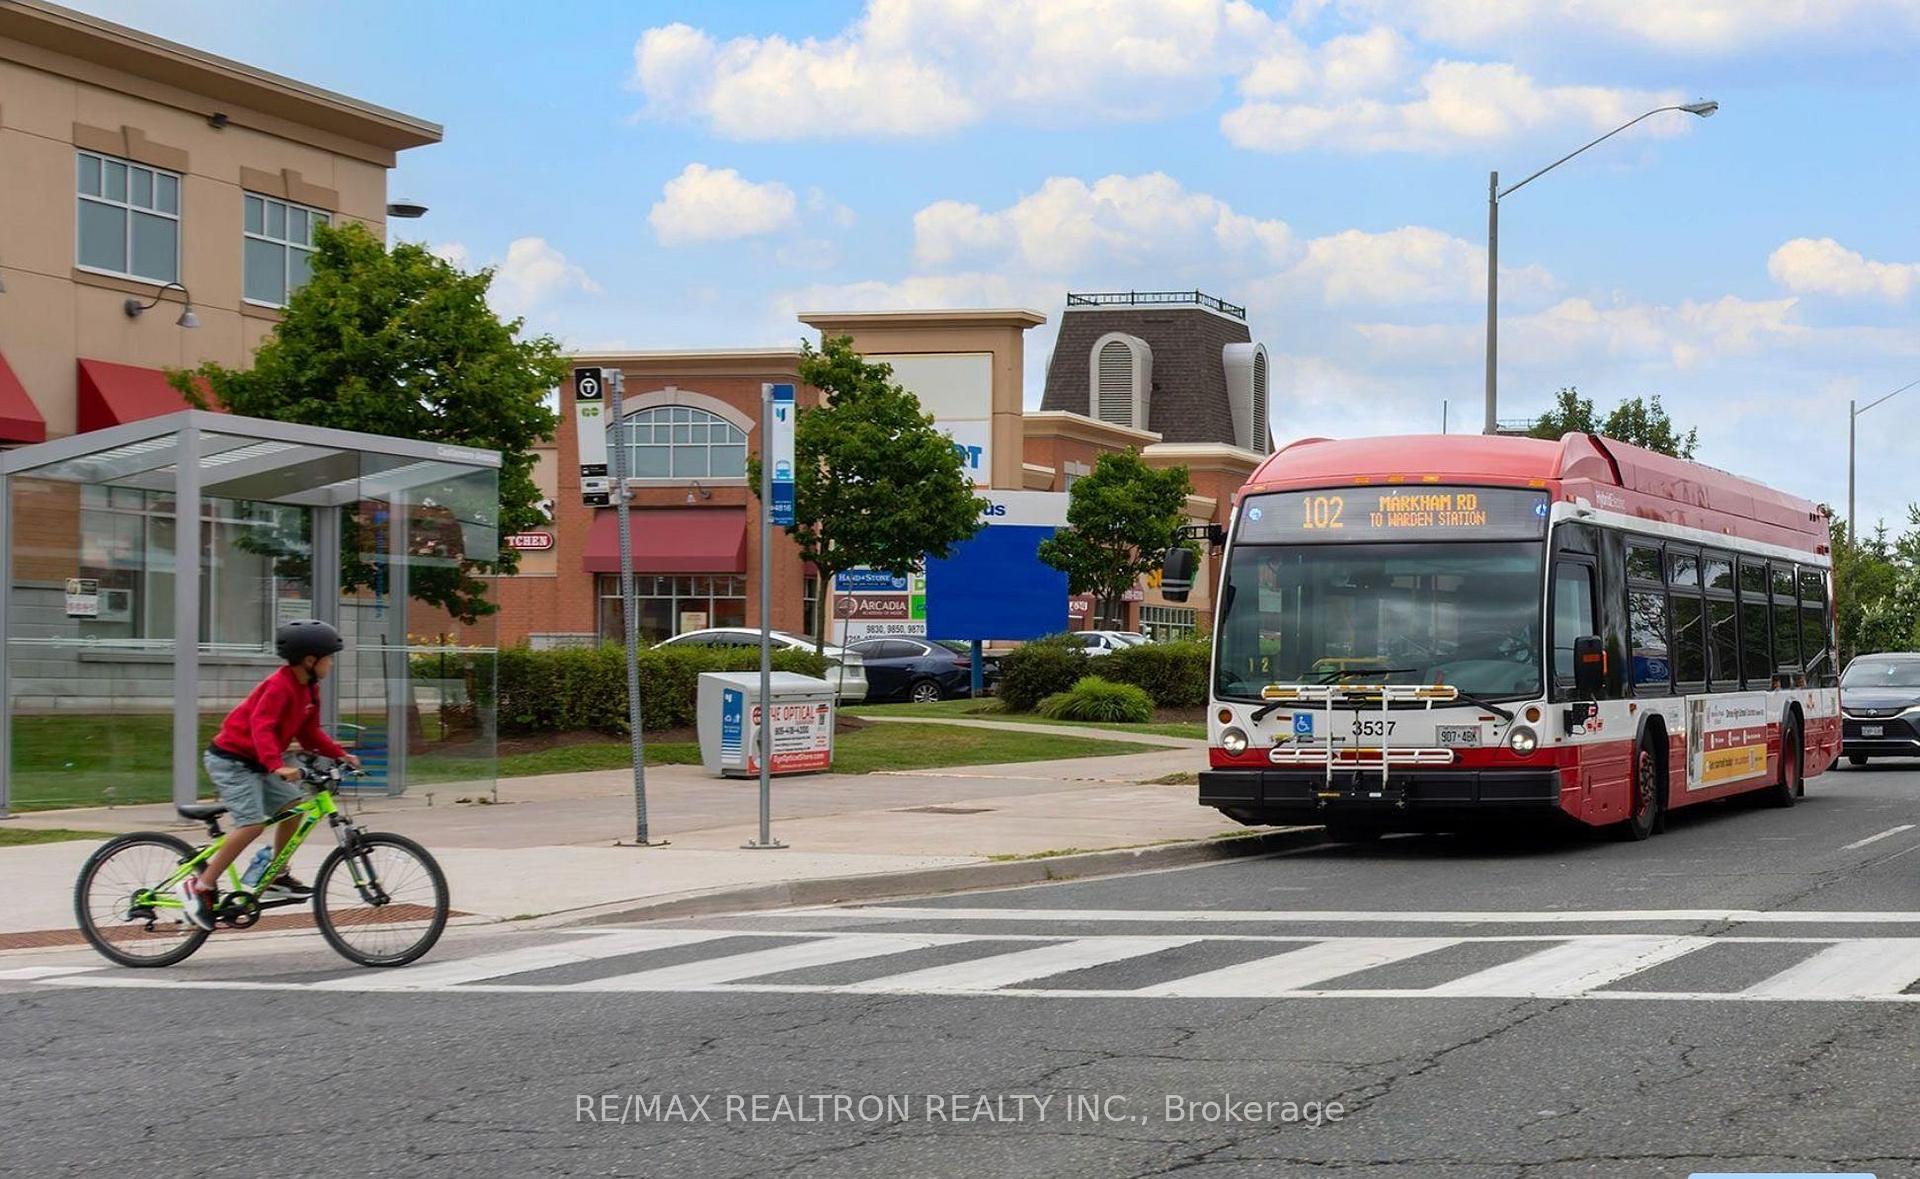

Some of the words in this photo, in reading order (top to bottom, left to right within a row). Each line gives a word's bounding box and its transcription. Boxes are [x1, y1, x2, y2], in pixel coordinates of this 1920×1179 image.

[1379, 495, 1451, 511] MARKHAM
[1457, 494, 1477, 510] RD
[1303, 496, 1344, 528] 102
[1370, 513, 1382, 527] TO
[1388, 511, 1433, 527] WARDEN
[1438, 511, 1486, 526] STATION
[859, 599, 906, 611] ARCADIA
[784, 704, 815, 721] OPTICAL
[1352, 721, 1396, 736] 3537
